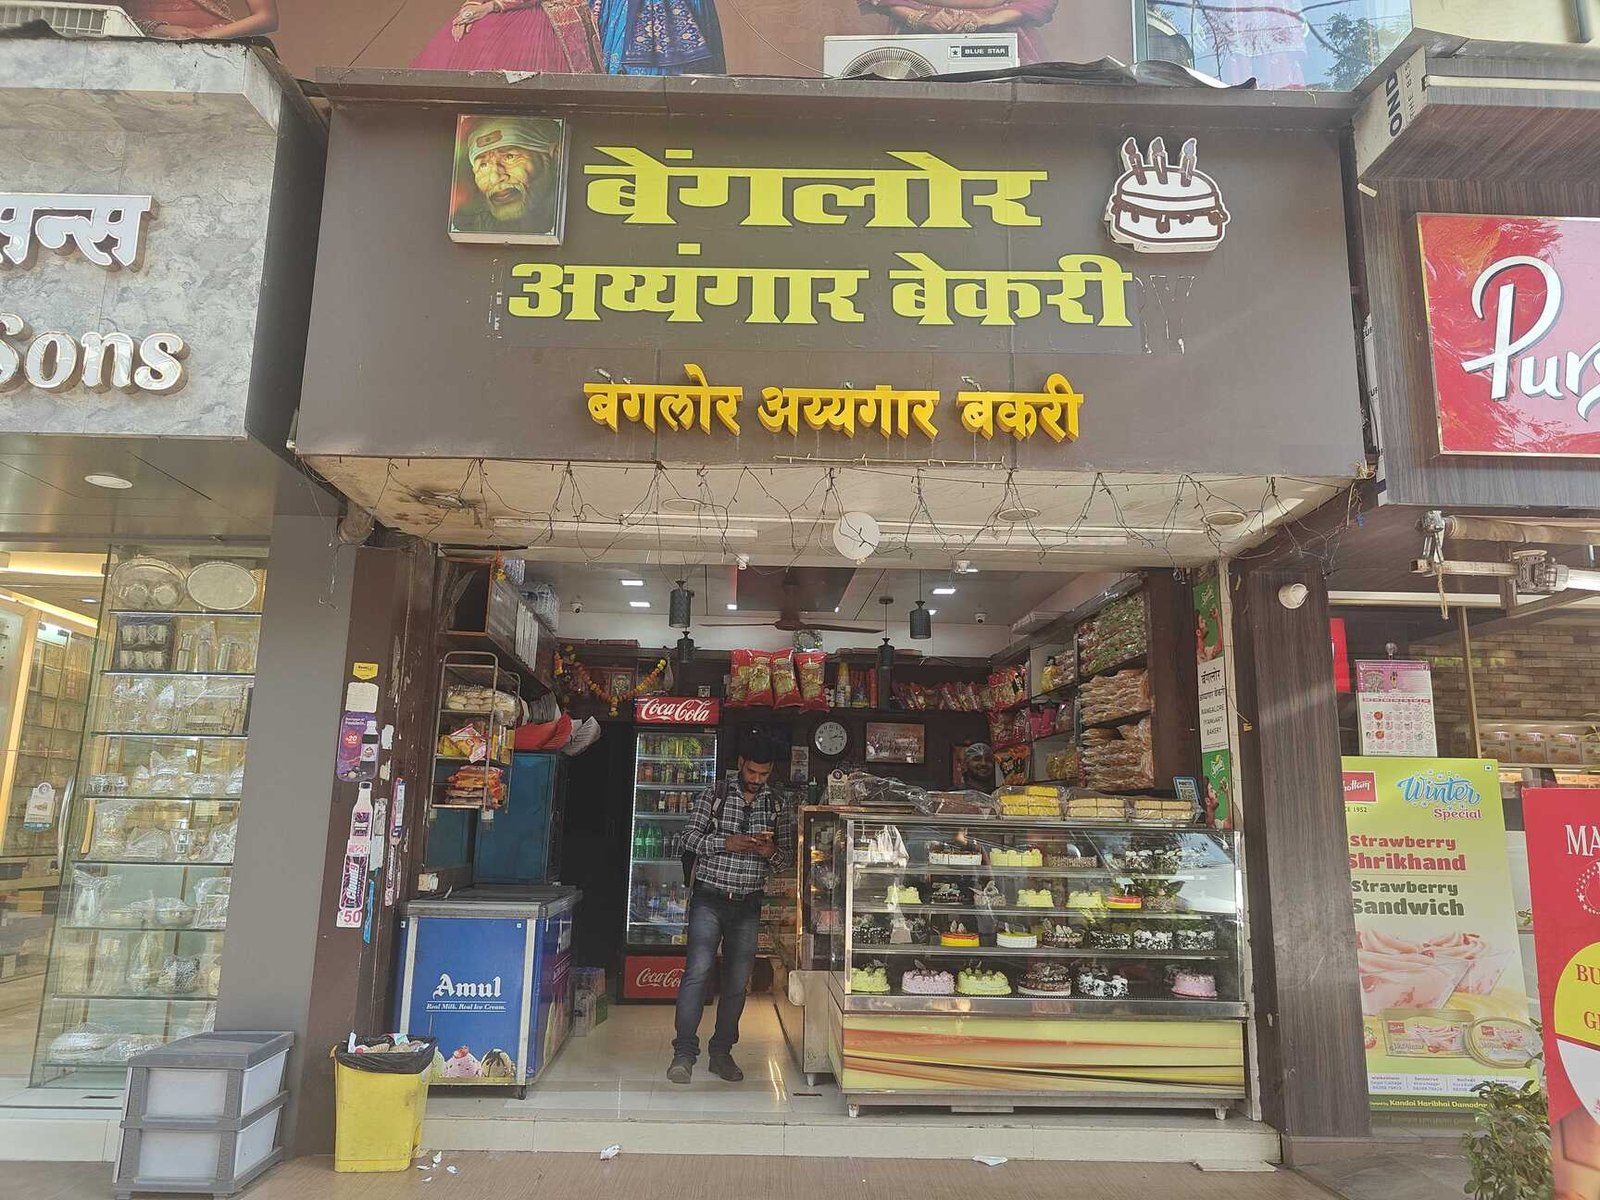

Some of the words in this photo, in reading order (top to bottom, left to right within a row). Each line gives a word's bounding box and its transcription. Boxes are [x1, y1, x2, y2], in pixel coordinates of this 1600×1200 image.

[583, 146, 1049, 227] बेंगलोर
[507, 242, 870, 325] अय्यंगार
[889, 252, 1134, 327] बेकरी
[1397, 775, 1482, 806] Winter
[1433, 808, 1482, 821] Special
[1350, 834, 1457, 851] Strawberry
[1350, 853, 1467, 871] Shrikhand
[1351, 880, 1459, 896] Strawberry
[1353, 898, 1465, 916] Sandwich
[344, 910, 361, 923] 50
[433, 973, 502, 1000] Amul
